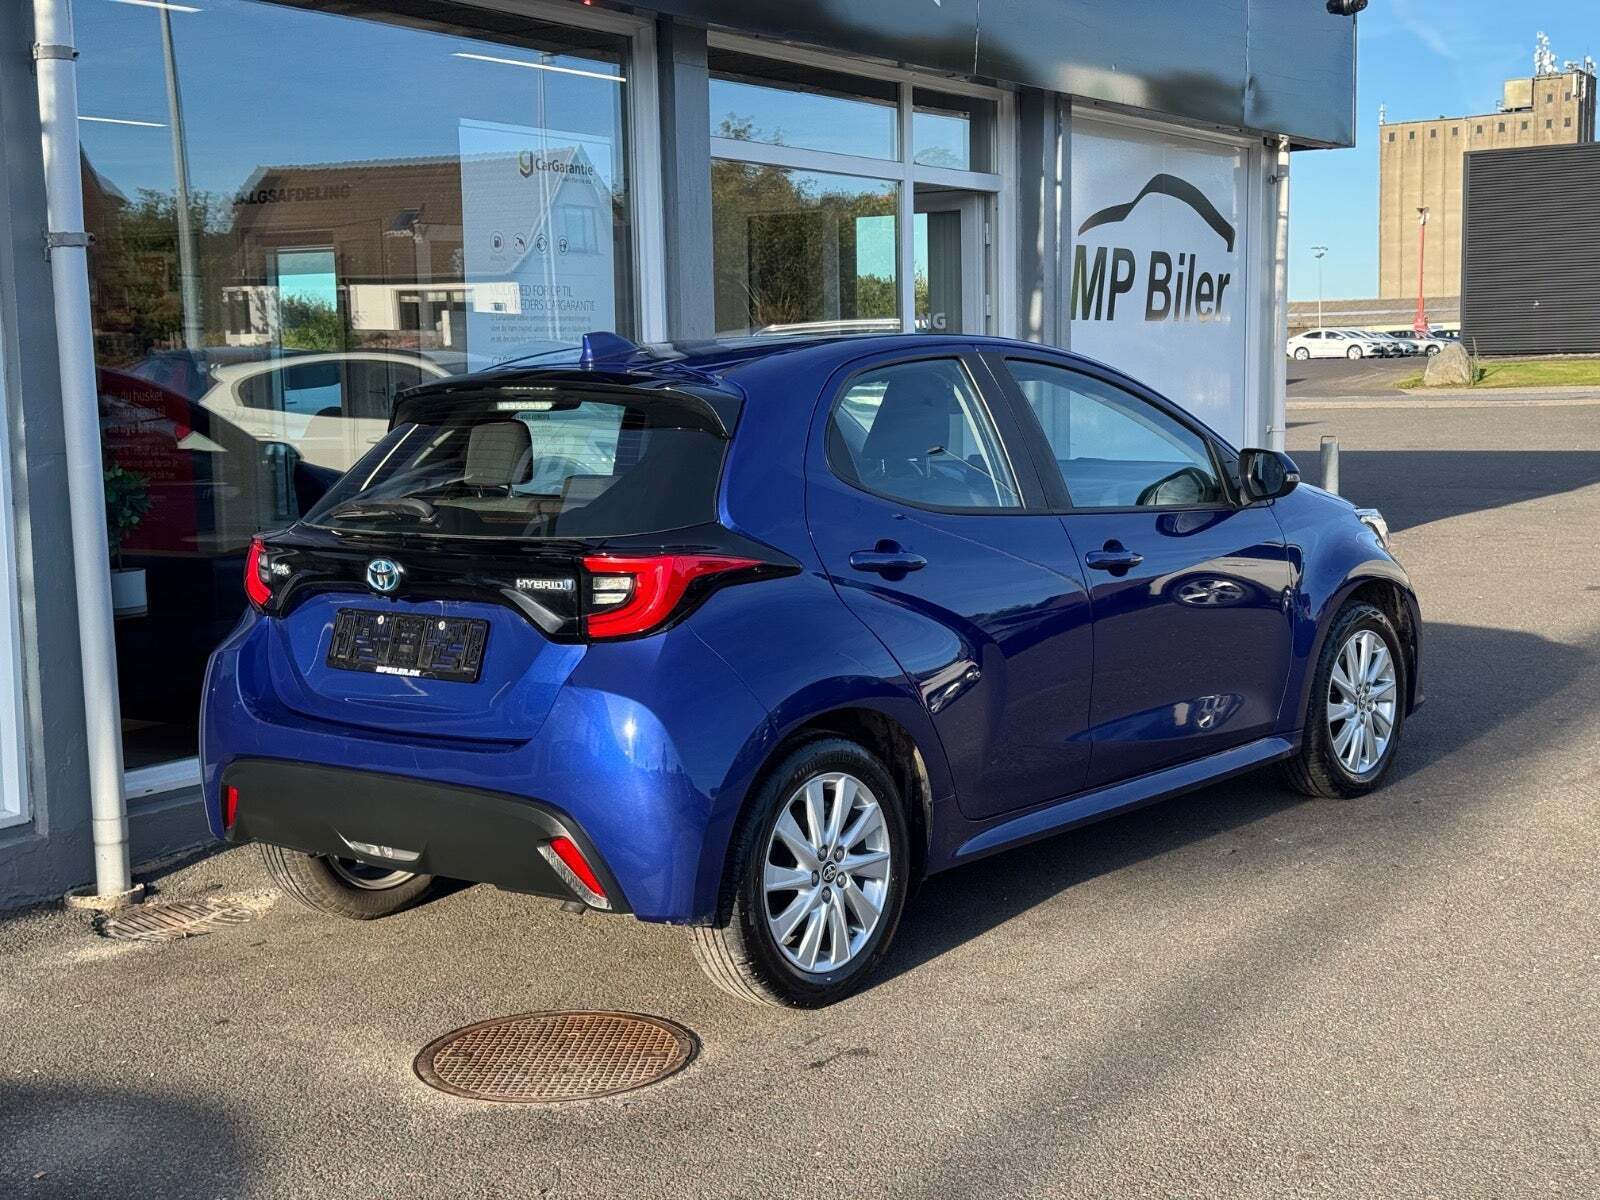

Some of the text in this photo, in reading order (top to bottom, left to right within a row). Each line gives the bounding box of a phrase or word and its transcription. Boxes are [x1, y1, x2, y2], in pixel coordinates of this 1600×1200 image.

[535, 158, 593, 176] CarGarantie
[233, 185, 350, 205] ALGSAFDELING
[1071, 244, 1231, 323] MP Biler
[515, 578, 563, 590] HYBRID
